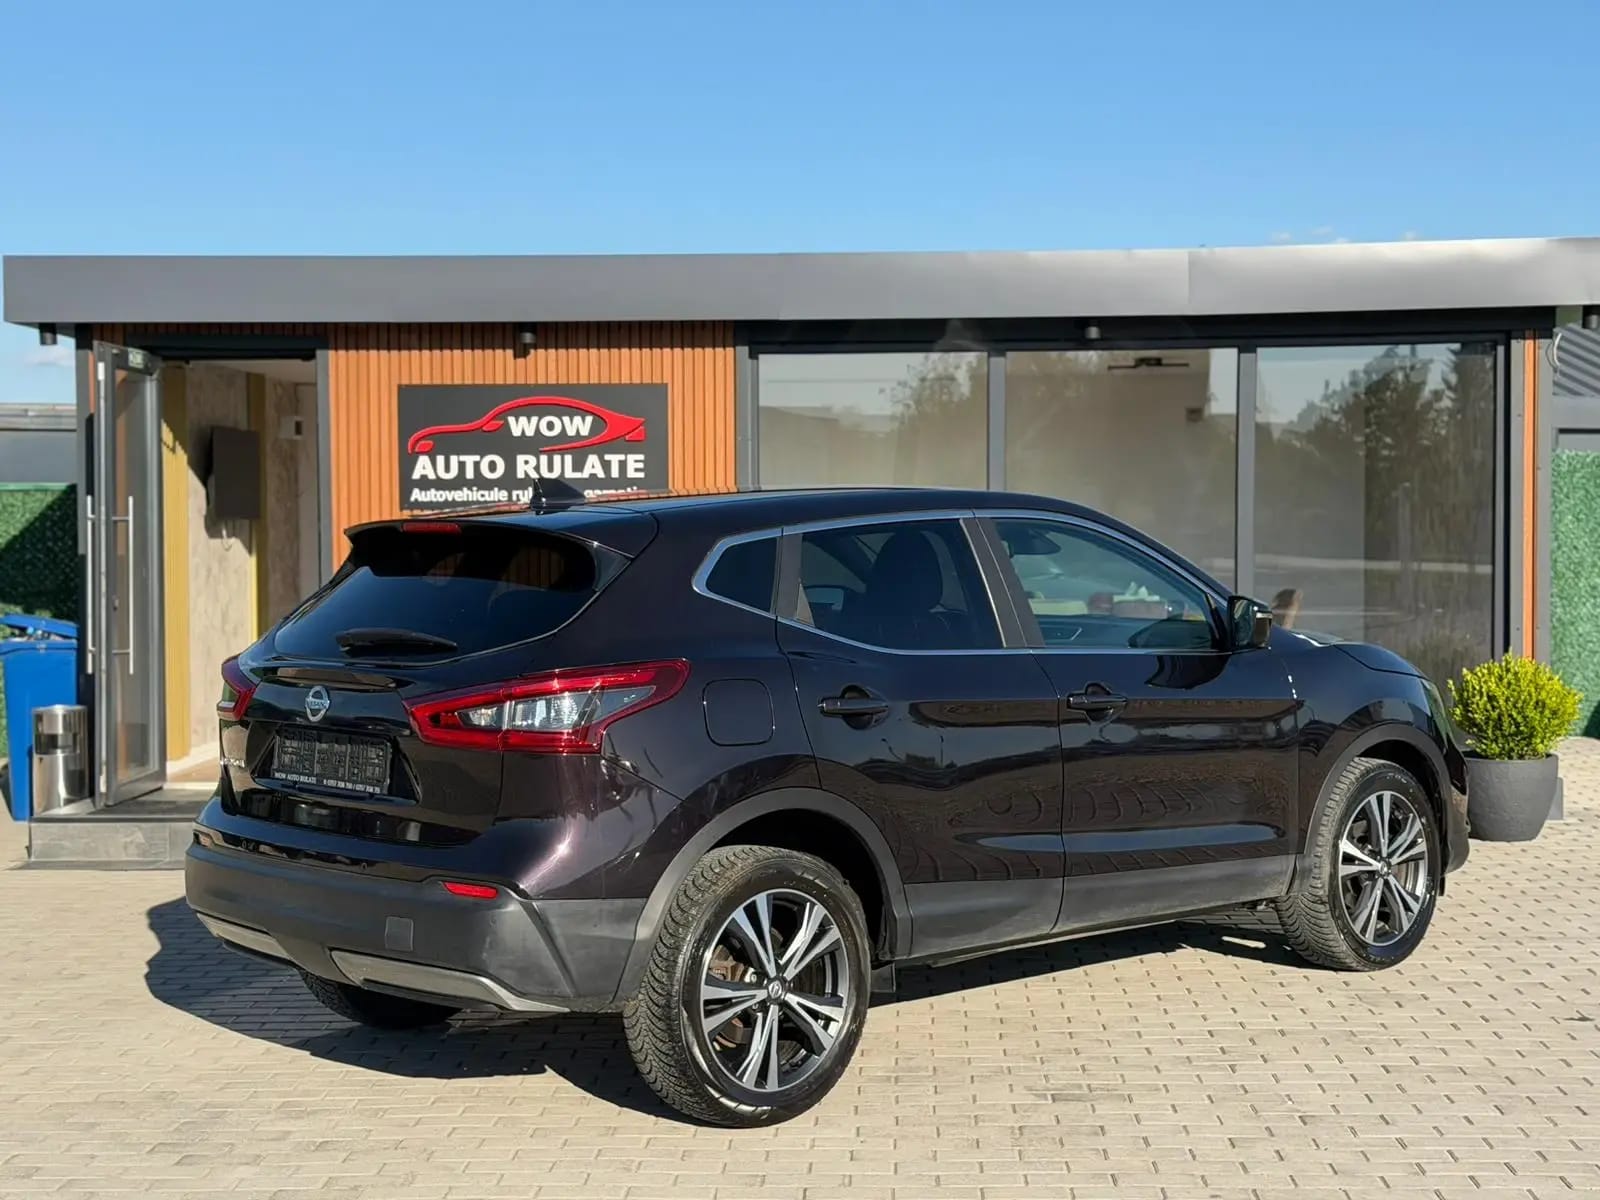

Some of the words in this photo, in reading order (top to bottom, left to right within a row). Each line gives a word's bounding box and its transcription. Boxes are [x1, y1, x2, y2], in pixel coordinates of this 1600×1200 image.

[507, 415, 593, 437] WOW
[411, 454, 505, 480] AUTO
[516, 453, 645, 479] RULATE
[410, 486, 508, 502] Autovehicule
[512, 486, 533, 502] rul
